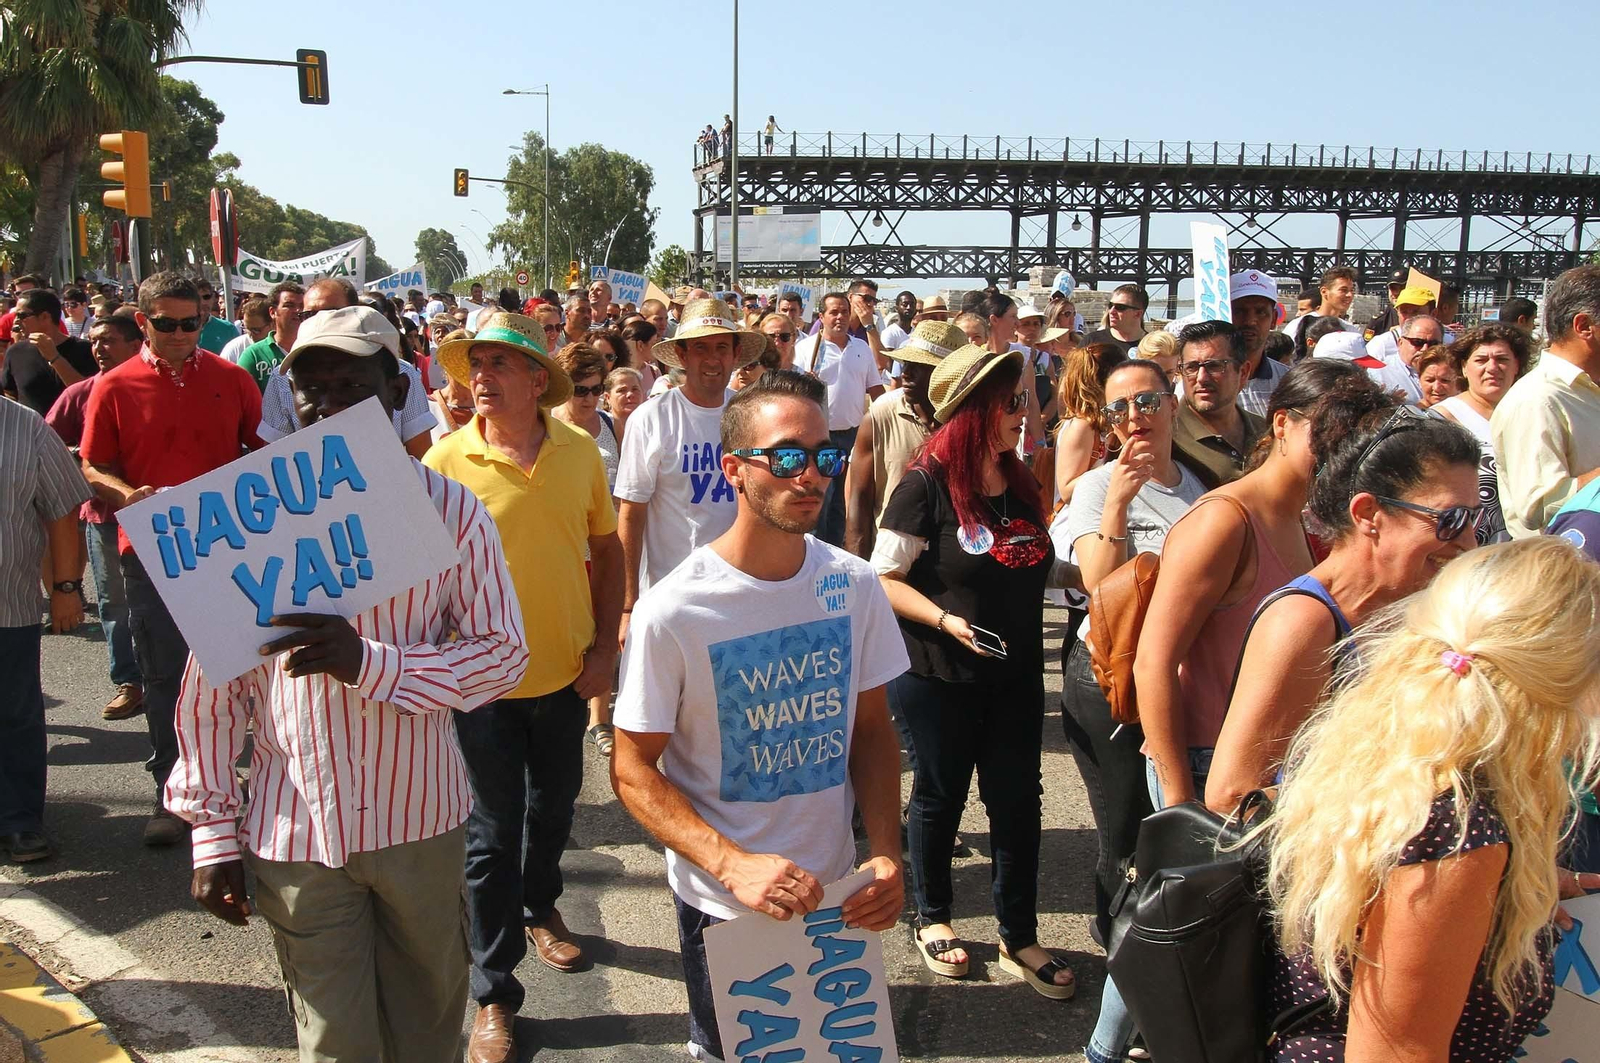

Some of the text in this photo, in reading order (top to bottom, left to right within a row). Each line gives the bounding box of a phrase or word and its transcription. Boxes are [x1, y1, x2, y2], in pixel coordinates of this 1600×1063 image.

[231, 514, 374, 627] YA!!
[825, 593, 846, 612] YA!!
[738, 647, 842, 694] WAVES
[745, 687, 842, 731] WAVES
[750, 729, 845, 775] WAVES
